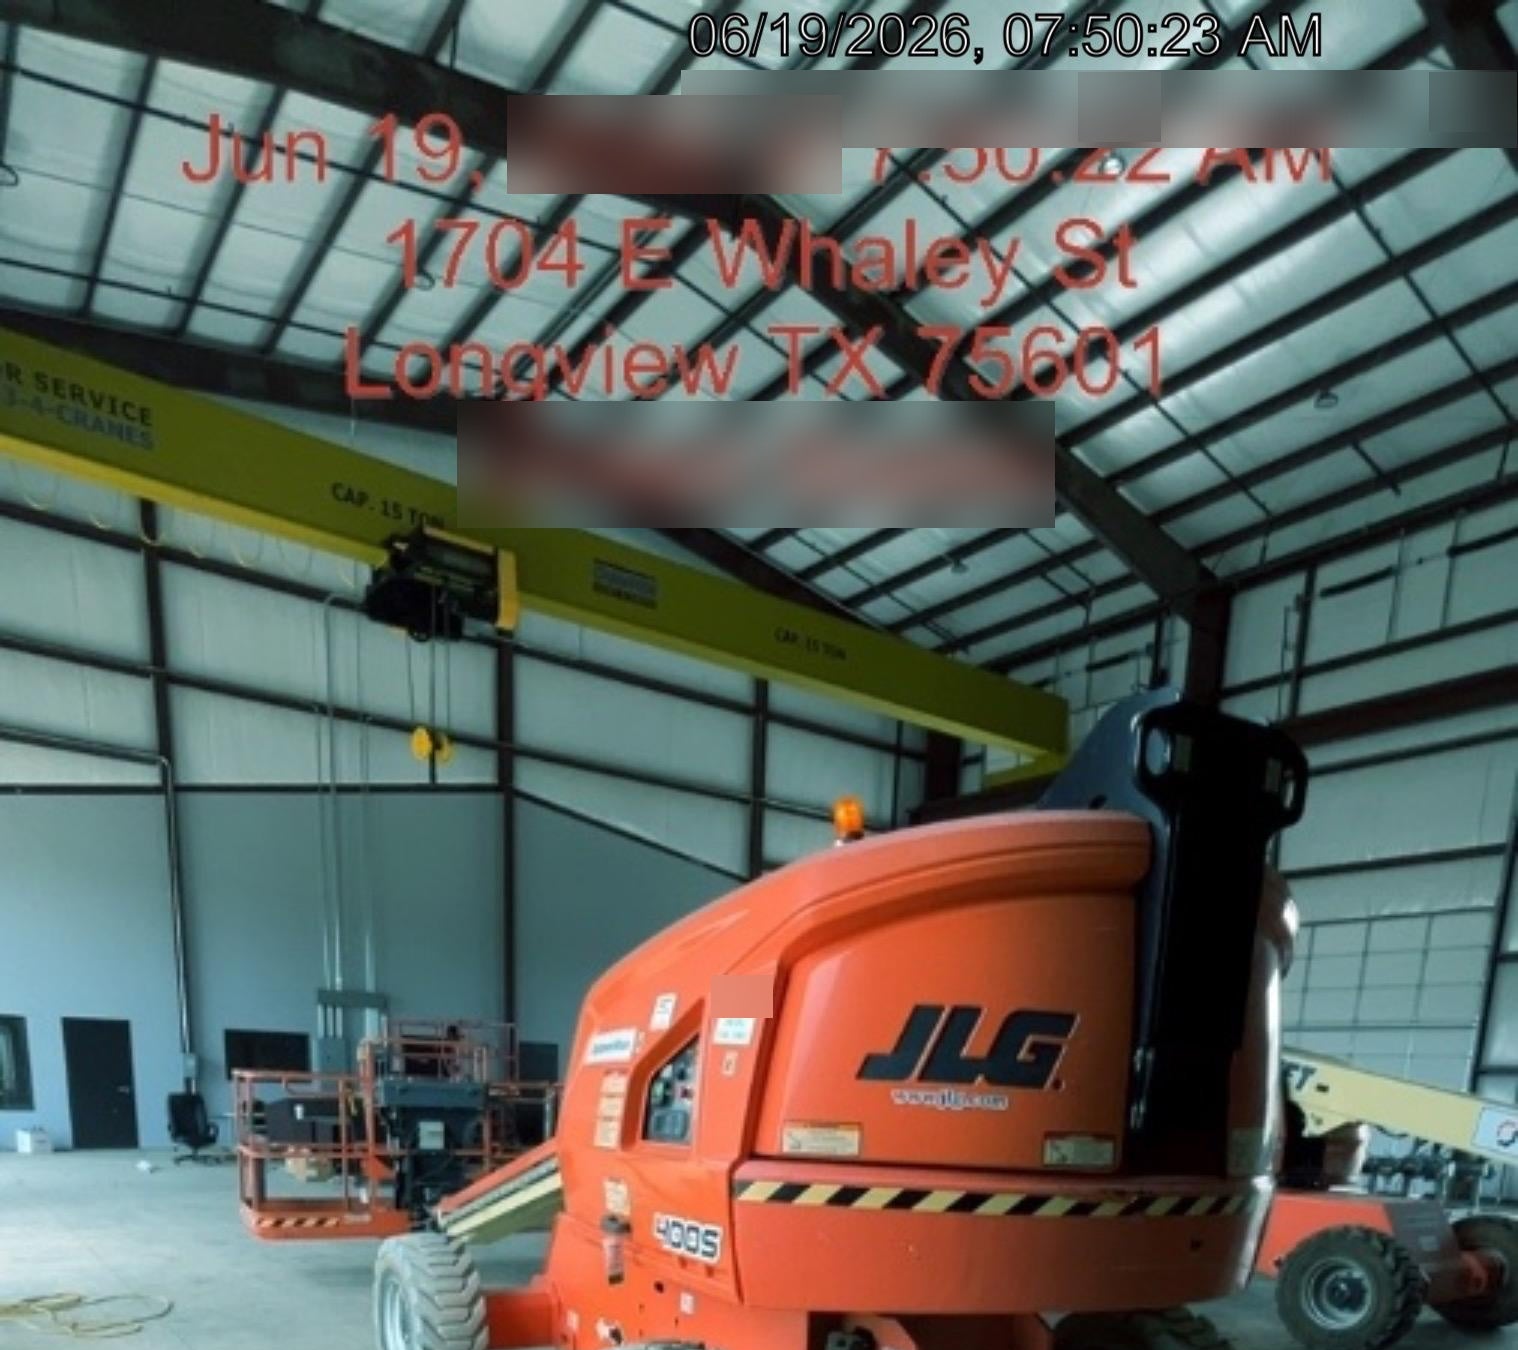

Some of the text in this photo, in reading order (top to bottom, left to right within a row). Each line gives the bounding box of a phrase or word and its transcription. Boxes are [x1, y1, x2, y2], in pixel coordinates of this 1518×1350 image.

[33, 369, 154, 428] SERVICE
[381, 498, 403, 520] 15
[856, 1004, 1080, 1090] JLG
[655, 1214, 720, 1259] 400S
